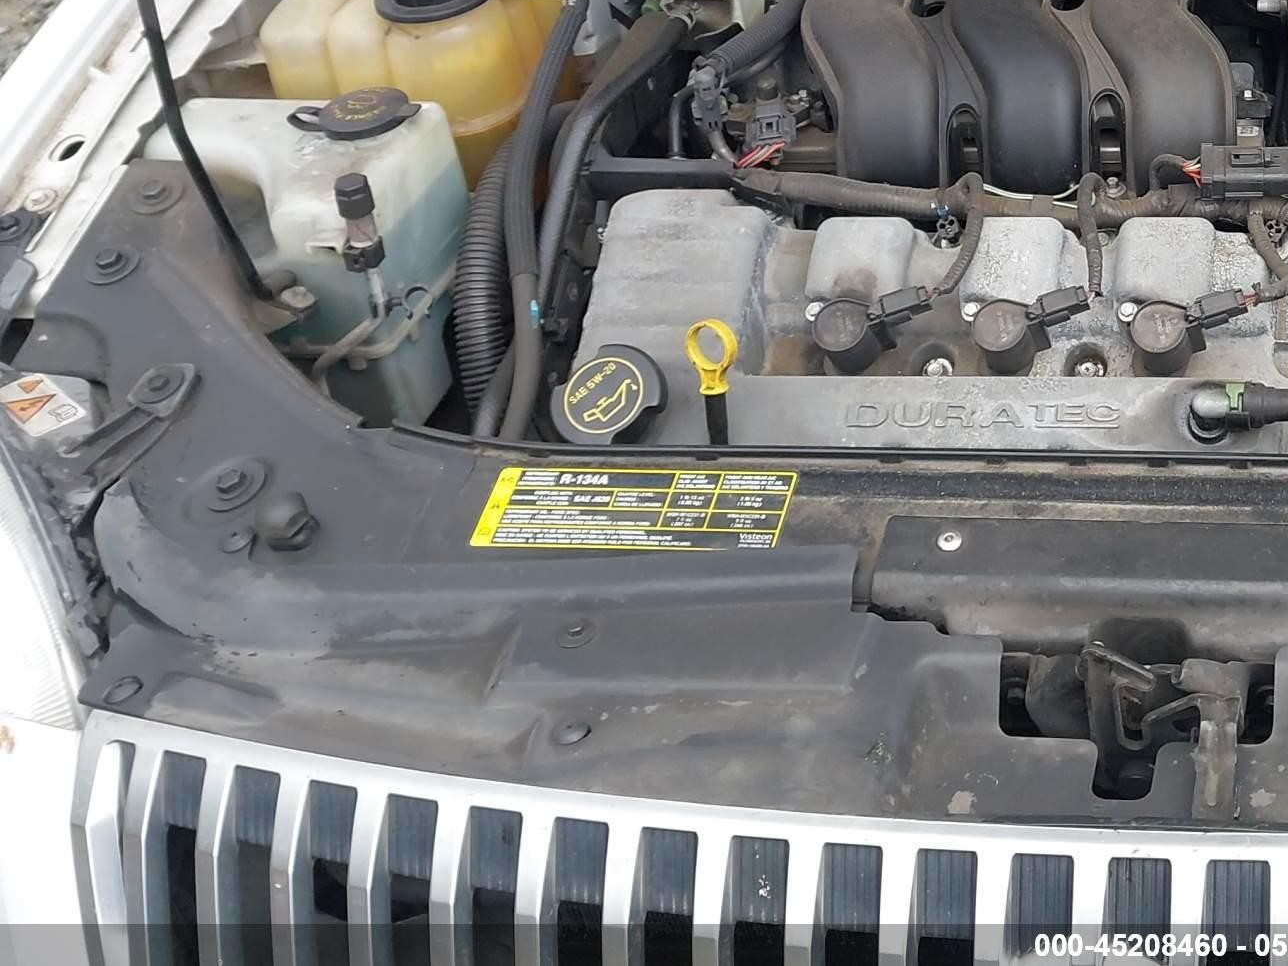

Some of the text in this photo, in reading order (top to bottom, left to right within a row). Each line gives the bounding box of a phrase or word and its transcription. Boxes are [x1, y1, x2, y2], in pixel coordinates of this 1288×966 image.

[568, 362, 617, 404] SAE 5W-20
[846, 401, 1120, 429] DURATEC
[559, 473, 609, 486] R-134A
